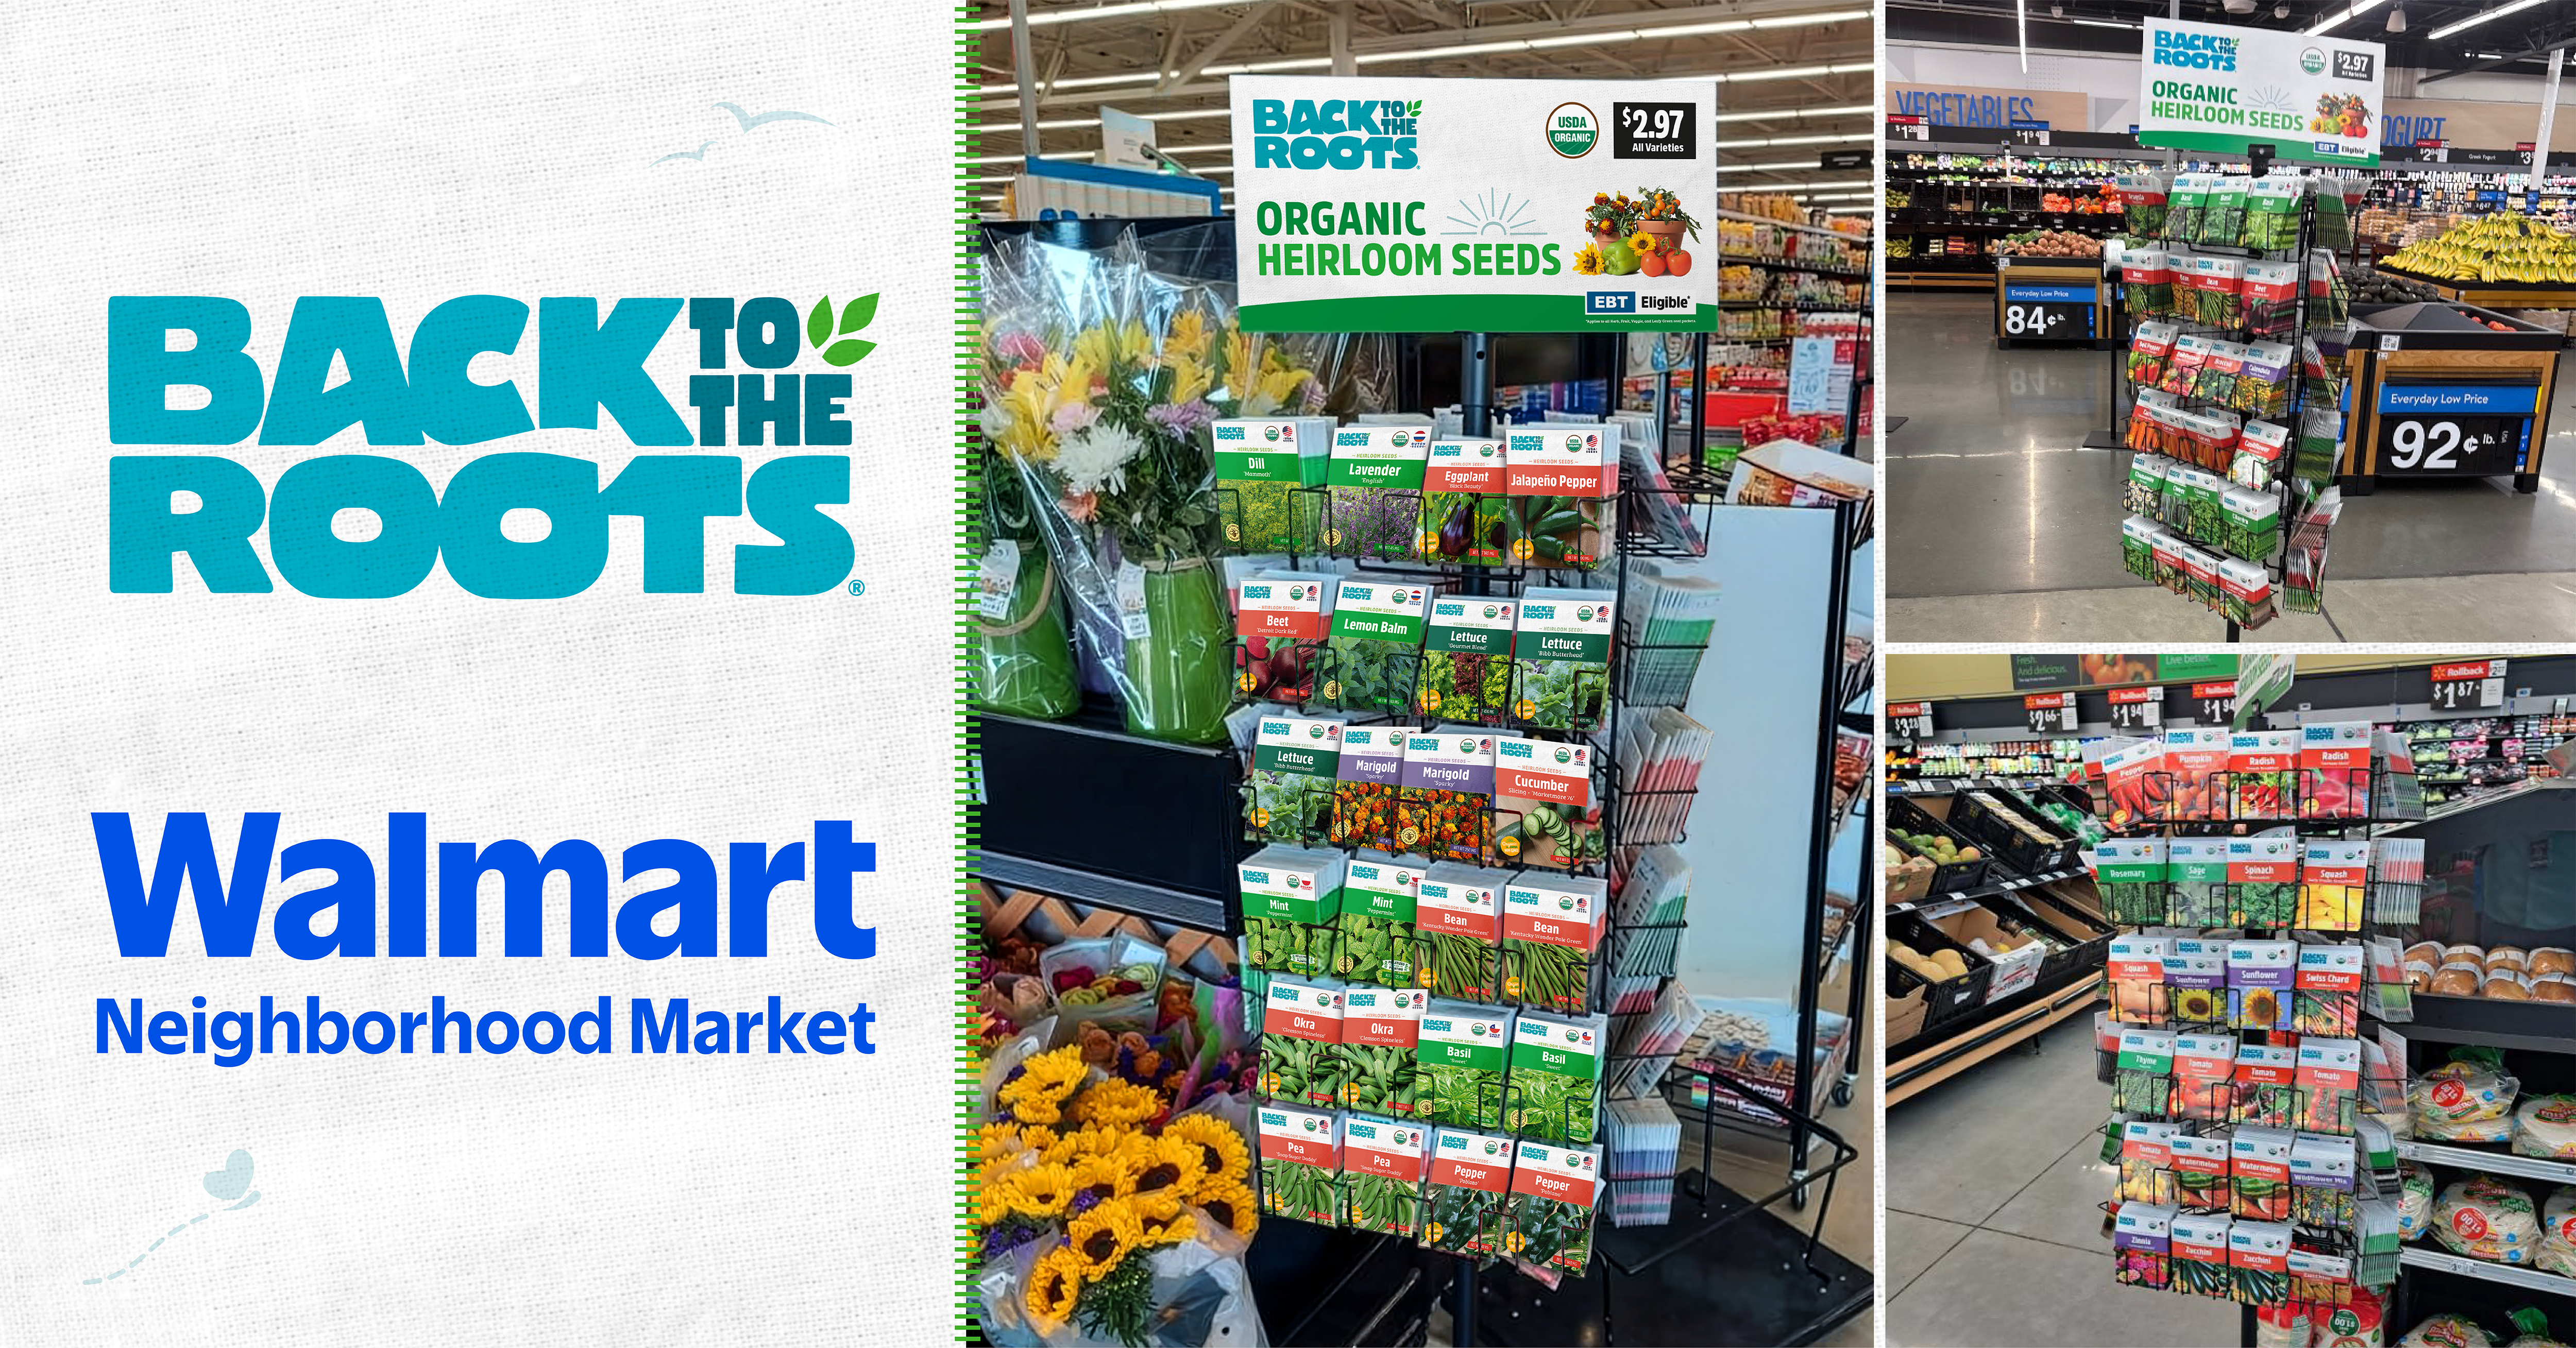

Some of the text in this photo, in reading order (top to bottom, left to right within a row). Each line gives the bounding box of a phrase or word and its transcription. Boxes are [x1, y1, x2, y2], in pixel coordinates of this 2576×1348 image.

[2154, 30, 2236, 55] BACK TO THE
[2154, 48, 2236, 72] ROOTS
[2338, 54, 2368, 72] $2.97
[2152, 80, 2238, 104] ORGANIC
[1895, 91, 2033, 127] VEGETABLES
[1253, 100, 1417, 135] BACK TO THE
[1558, 116, 1587, 128] USDA
[2151, 101, 2303, 131] HEIRLOOM SEEDS
[1622, 108, 1684, 139] $2.97
[2381, 115, 2446, 146] OGURT
[1555, 132, 1590, 144] ORGANIC
[1633, 143, 1684, 152] All Varieties
[1257, 201, 1426, 236] ORGANIC
[1259, 243, 1561, 276] HEIRLOOM SEEDS
[1596, 296, 1628, 308] EBT
[2391, 394, 2488, 406] Everyday Low Price
[2483, 434, 2495, 444] lb.
[1248, 457, 1265, 471] Dill
[1349, 464, 1401, 477] Lavender
[1445, 471, 1489, 484] Eggplant
[1511, 473, 1597, 489] Jalapeño Pepper
[1267, 615, 1289, 627] Beet
[1344, 619, 1408, 635] Lemon Balm
[1450, 631, 1487, 643] Lettuce
[1541, 638, 1582, 651] Lettuce
[2448, 667, 2483, 676] Rollback
[1277, 752, 1314, 765] Lettuce
[2249, 757, 2275, 765] Radish
[2321, 751, 2349, 761] Radish
[1356, 760, 1397, 774] Marigold
[1423, 767, 1469, 781] Marigold
[1515, 774, 1569, 792] Cucumber
[2245, 866, 2274, 875] Spinach
[2320, 870, 2347, 879] Squash
[1269, 898, 1289, 911] Mint
[1372, 896, 1393, 909] Mint
[1444, 914, 1467, 926] Bean
[1534, 921, 1560, 934] Bean
[2242, 970, 2277, 979] Sunflower
[1294, 1016, 1315, 1030] Okra
[1371, 1022, 1394, 1035] Okra
[1447, 1046, 1471, 1059] Basil
[1542, 1051, 1565, 1065] Basil
[1288, 1141, 1304, 1154] Pea
[1374, 1155, 1391, 1167] Pea
[1454, 1165, 1487, 1181] Pepper
[1535, 1175, 1570, 1192] Pepper
[2185, 1247, 2212, 1256] Zucchini
[2243, 1255, 2271, 1264] Zucchini
